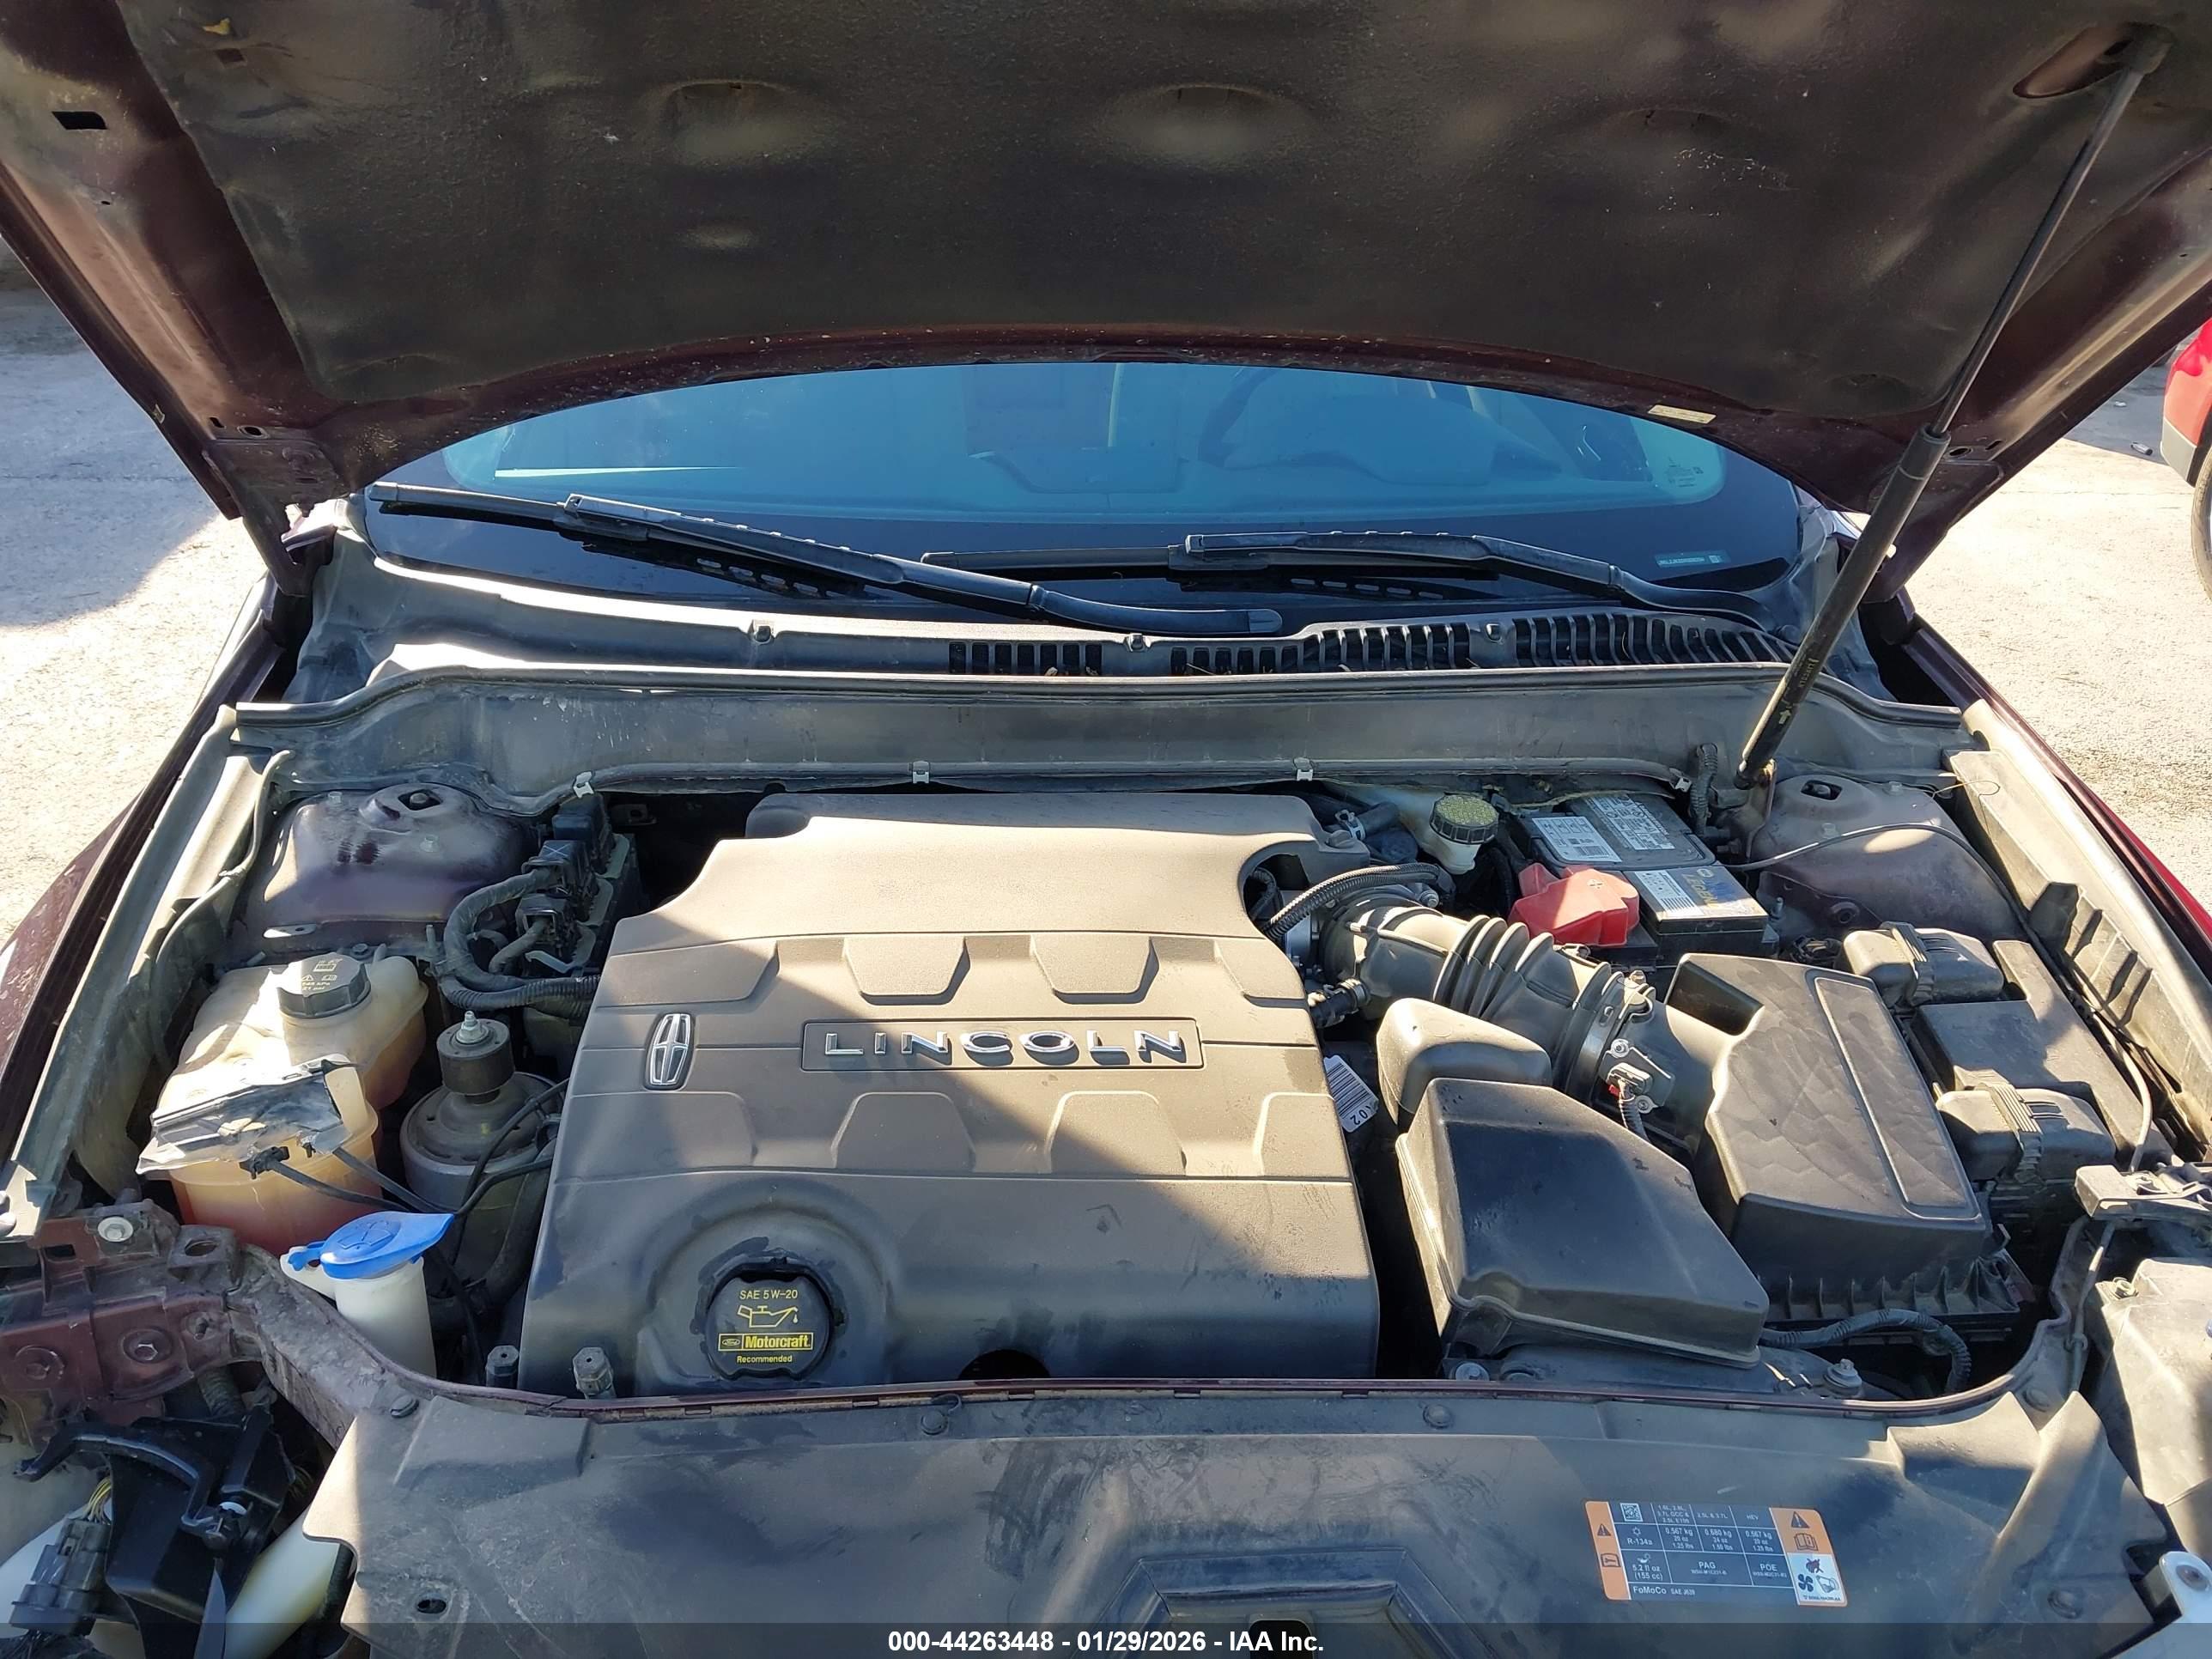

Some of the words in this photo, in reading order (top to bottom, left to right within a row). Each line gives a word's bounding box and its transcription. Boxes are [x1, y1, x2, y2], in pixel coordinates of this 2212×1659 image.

[824, 1030, 1183, 1055] LINCOLN
[739, 1291, 760, 1300] SAE
[745, 1334, 809, 1349] Motorcraft
[736, 1354, 793, 1364] Recommended
[1684, 1528, 1693, 1536] kg
[1723, 1529, 1732, 1538] kg
[1764, 1531, 1772, 1540] kg
[1626, 1537, 1653, 1546] R-134a
[1698, 1561, 1716, 1570] PAG
[1634, 1571, 1650, 1580] (155
[1651, 1572, 1663, 1581] cc)
[1633, 1585, 1667, 1595] FoMoCo
